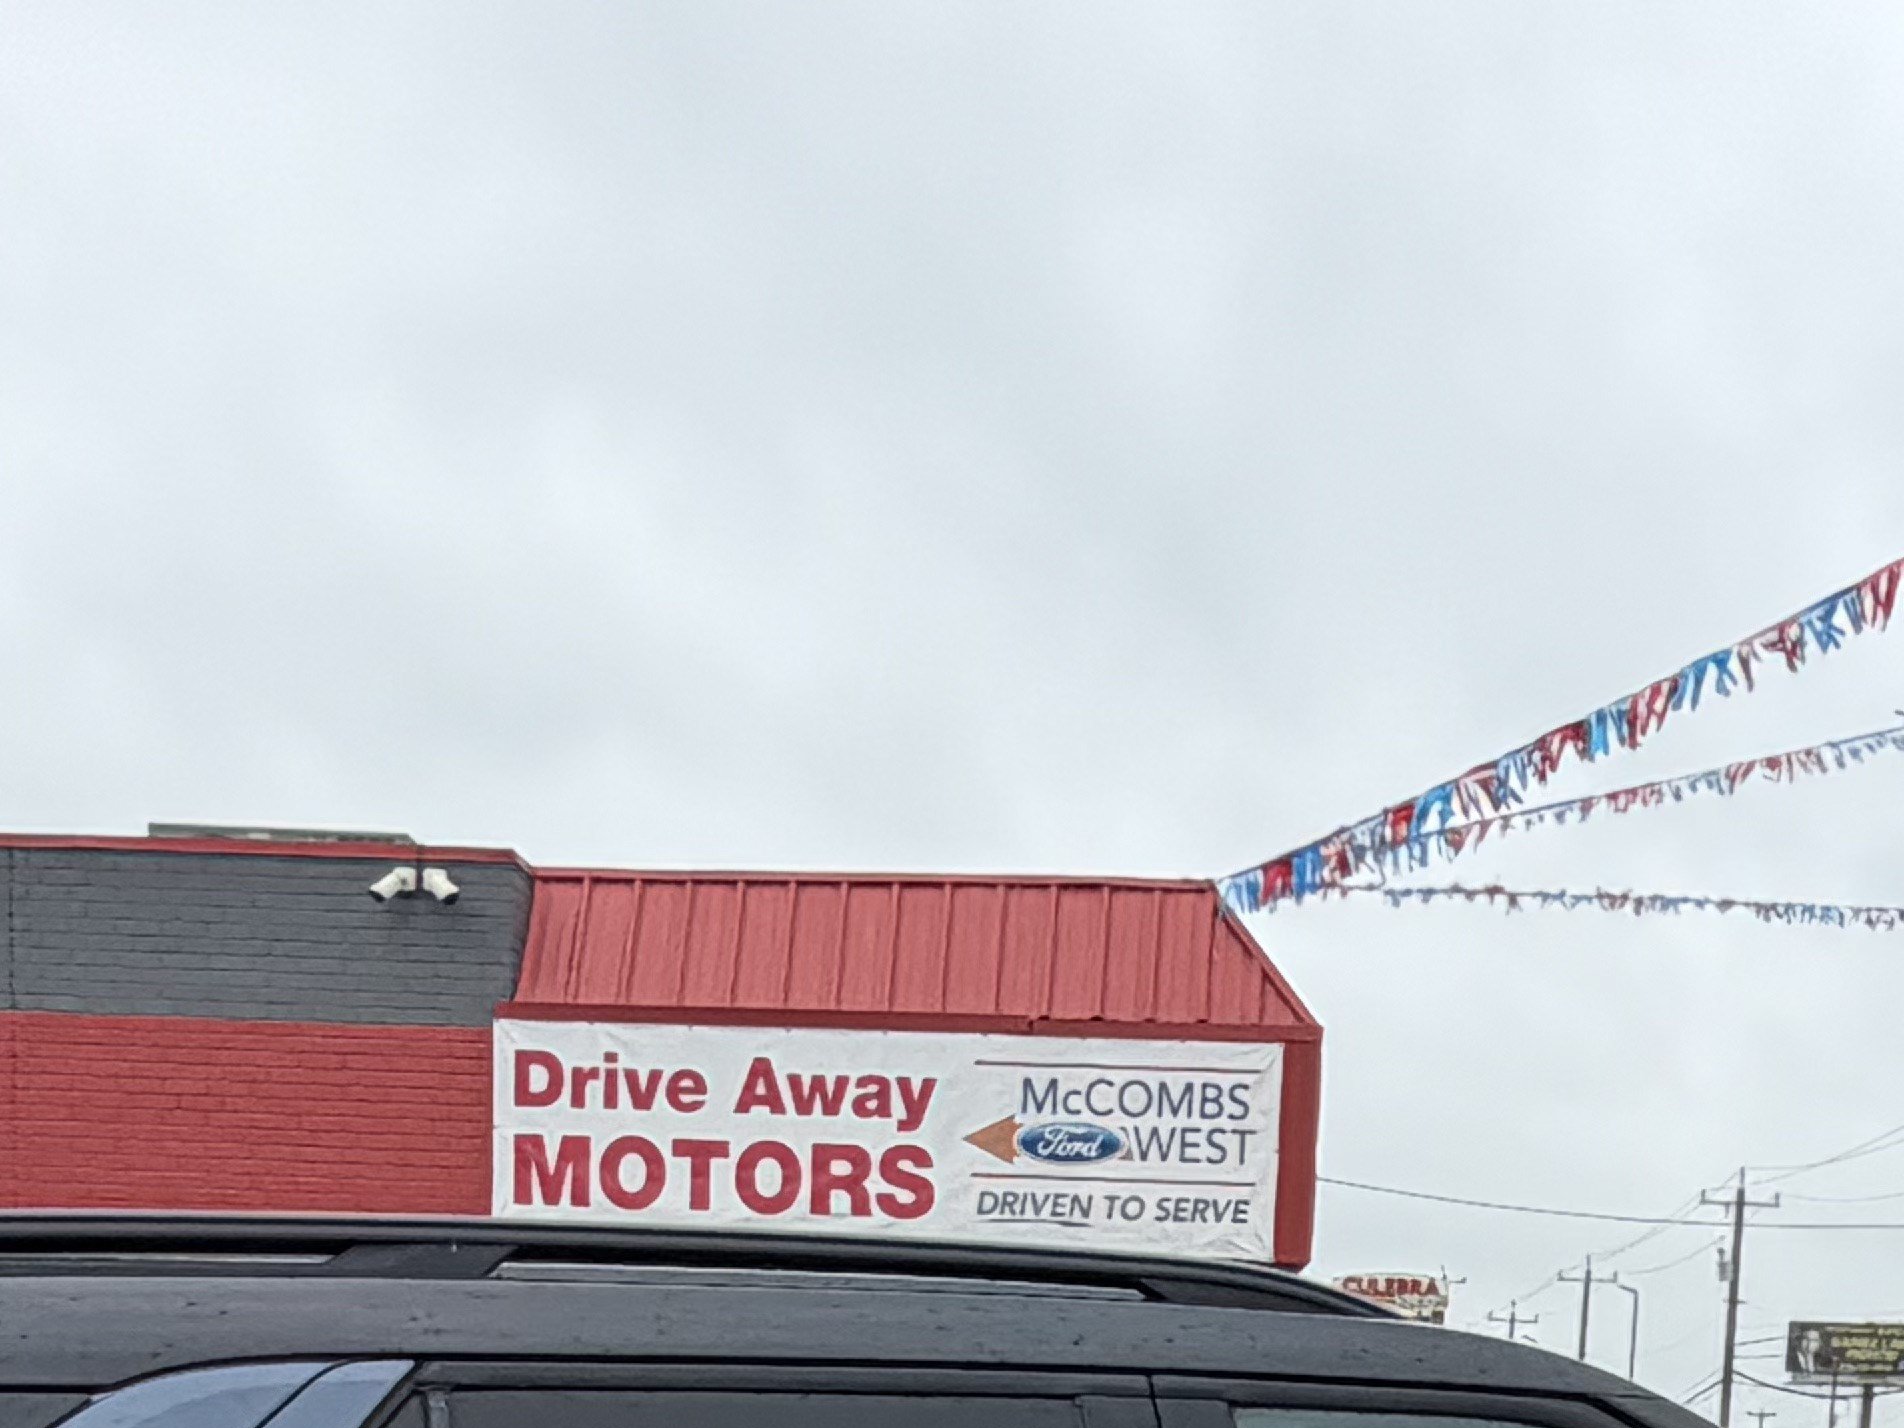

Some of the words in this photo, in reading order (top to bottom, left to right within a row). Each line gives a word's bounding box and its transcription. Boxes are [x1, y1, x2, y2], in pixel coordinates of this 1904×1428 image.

[514, 1049, 708, 1113] Drive
[733, 1056, 938, 1132] Away
[1020, 1076, 1251, 1121] McCOMBS
[1035, 1126, 1103, 1157] Ford
[1133, 1126, 1258, 1166] WEST
[512, 1133, 936, 1221] MOTORS
[976, 1190, 1094, 1219] DRIVEN
[1102, 1194, 1145, 1221] TO
[1153, 1198, 1251, 1224] SERVE
